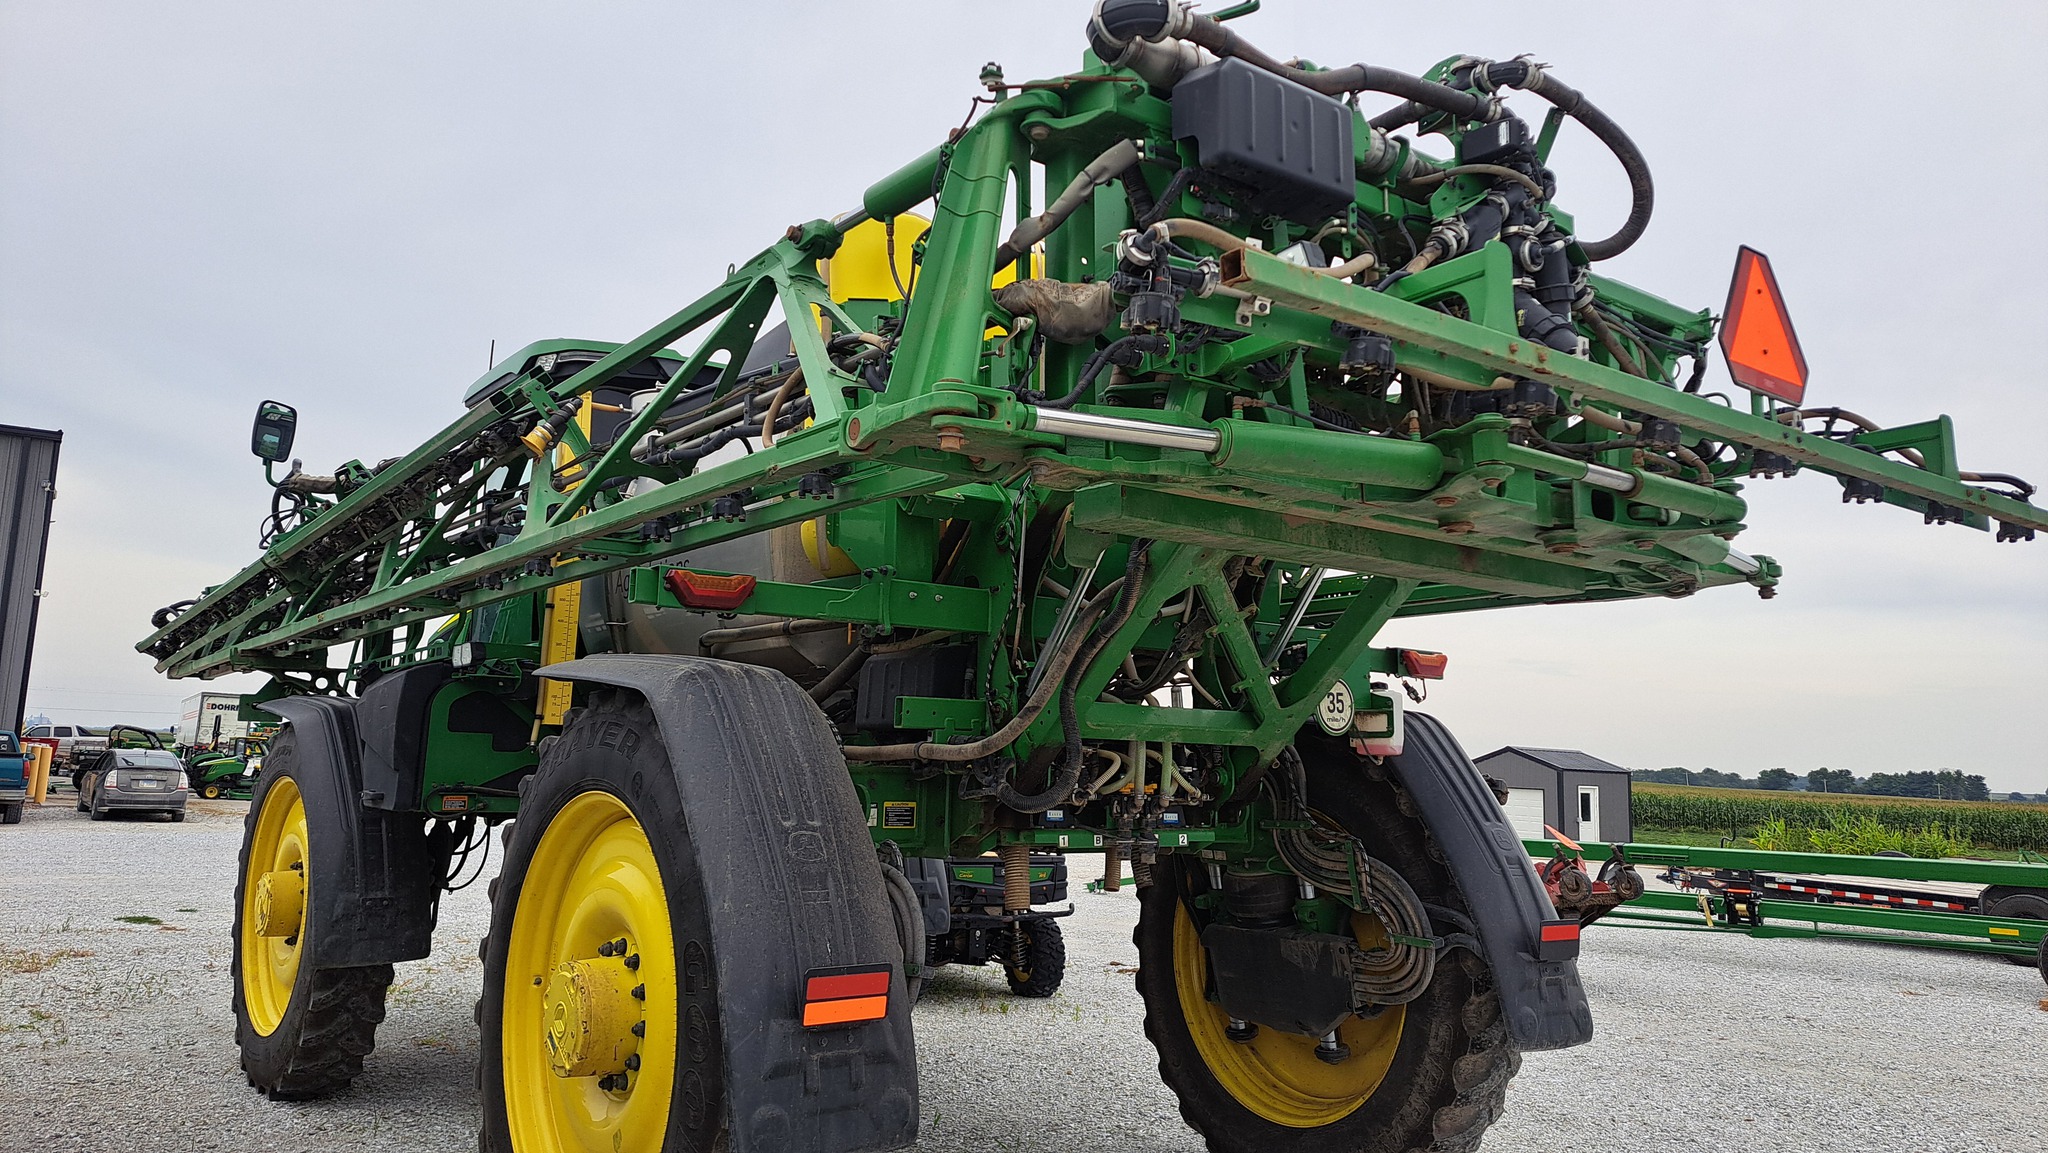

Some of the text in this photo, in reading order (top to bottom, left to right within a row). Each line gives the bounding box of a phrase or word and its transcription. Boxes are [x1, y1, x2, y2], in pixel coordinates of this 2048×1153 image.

[1327, 692, 1345, 714] 35
[1061, 837, 1066, 846] 1
[1096, 837, 1101, 845] B
[1180, 835, 1186, 844] 2
